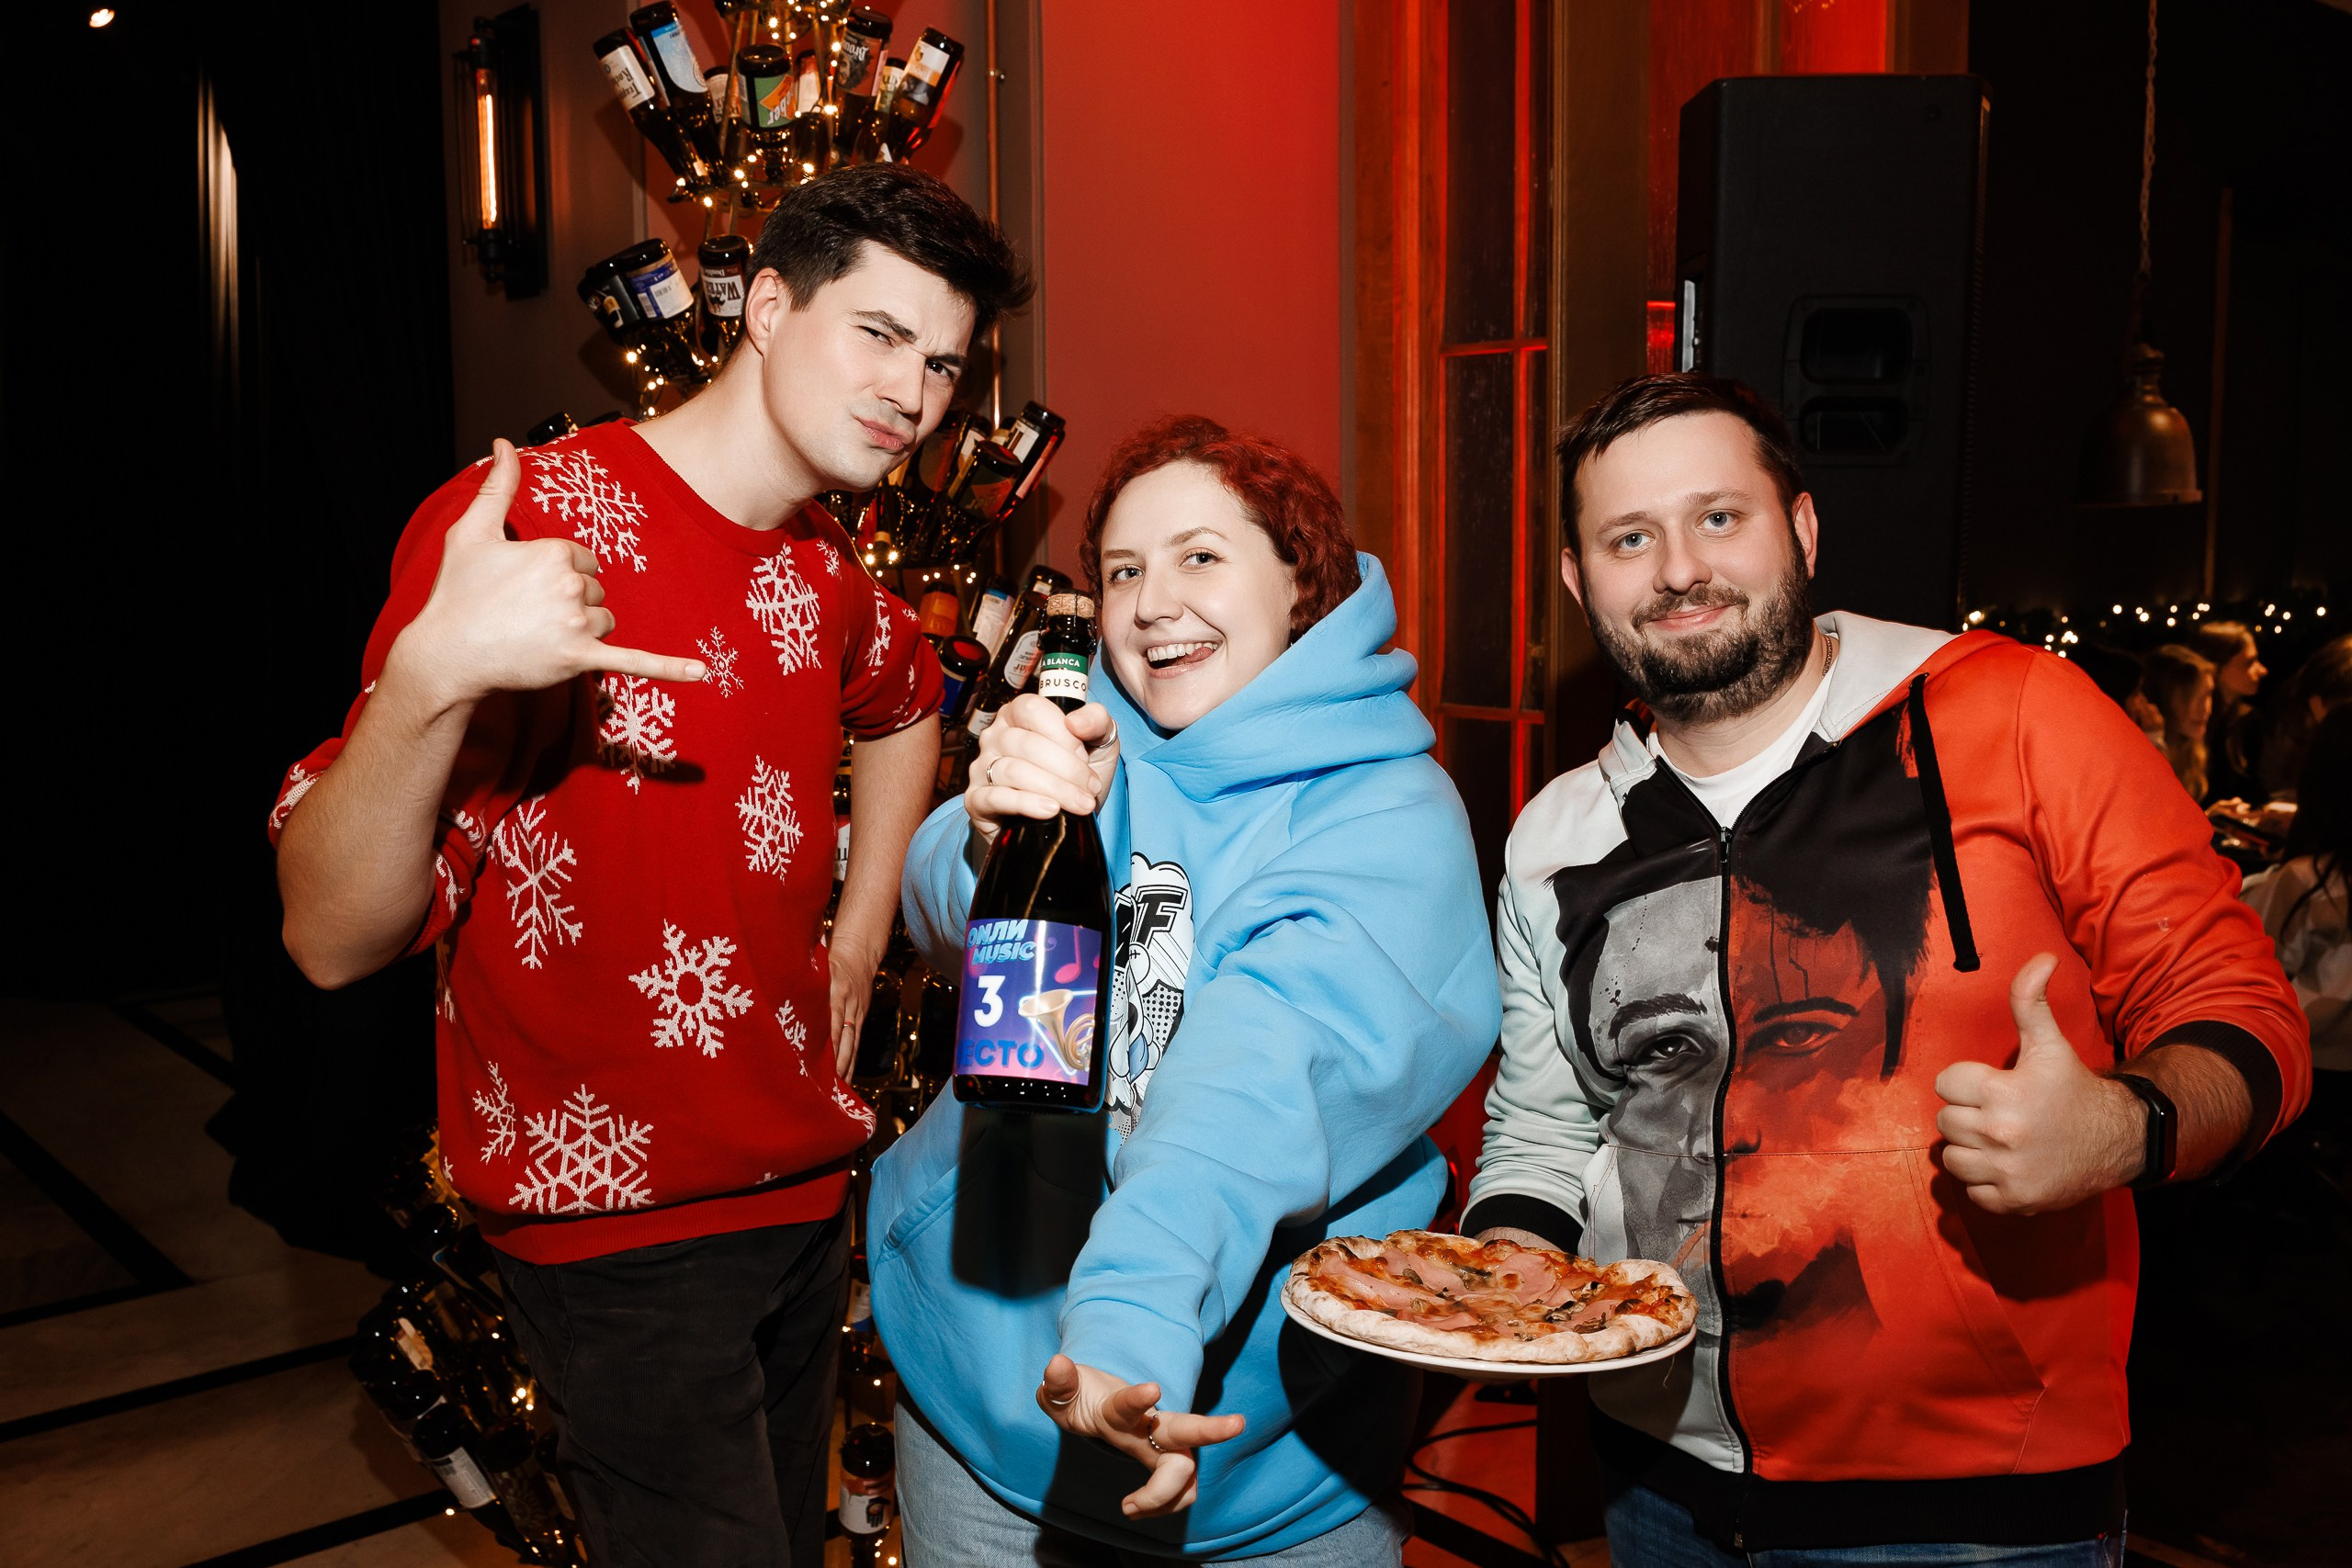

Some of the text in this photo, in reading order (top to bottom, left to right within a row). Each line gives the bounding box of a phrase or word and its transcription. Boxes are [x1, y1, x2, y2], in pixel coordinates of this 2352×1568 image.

[1046, 658, 1080, 668] BLANCA
[971, 941, 1037, 965] MUSIC
[974, 975, 1006, 1027] 3
